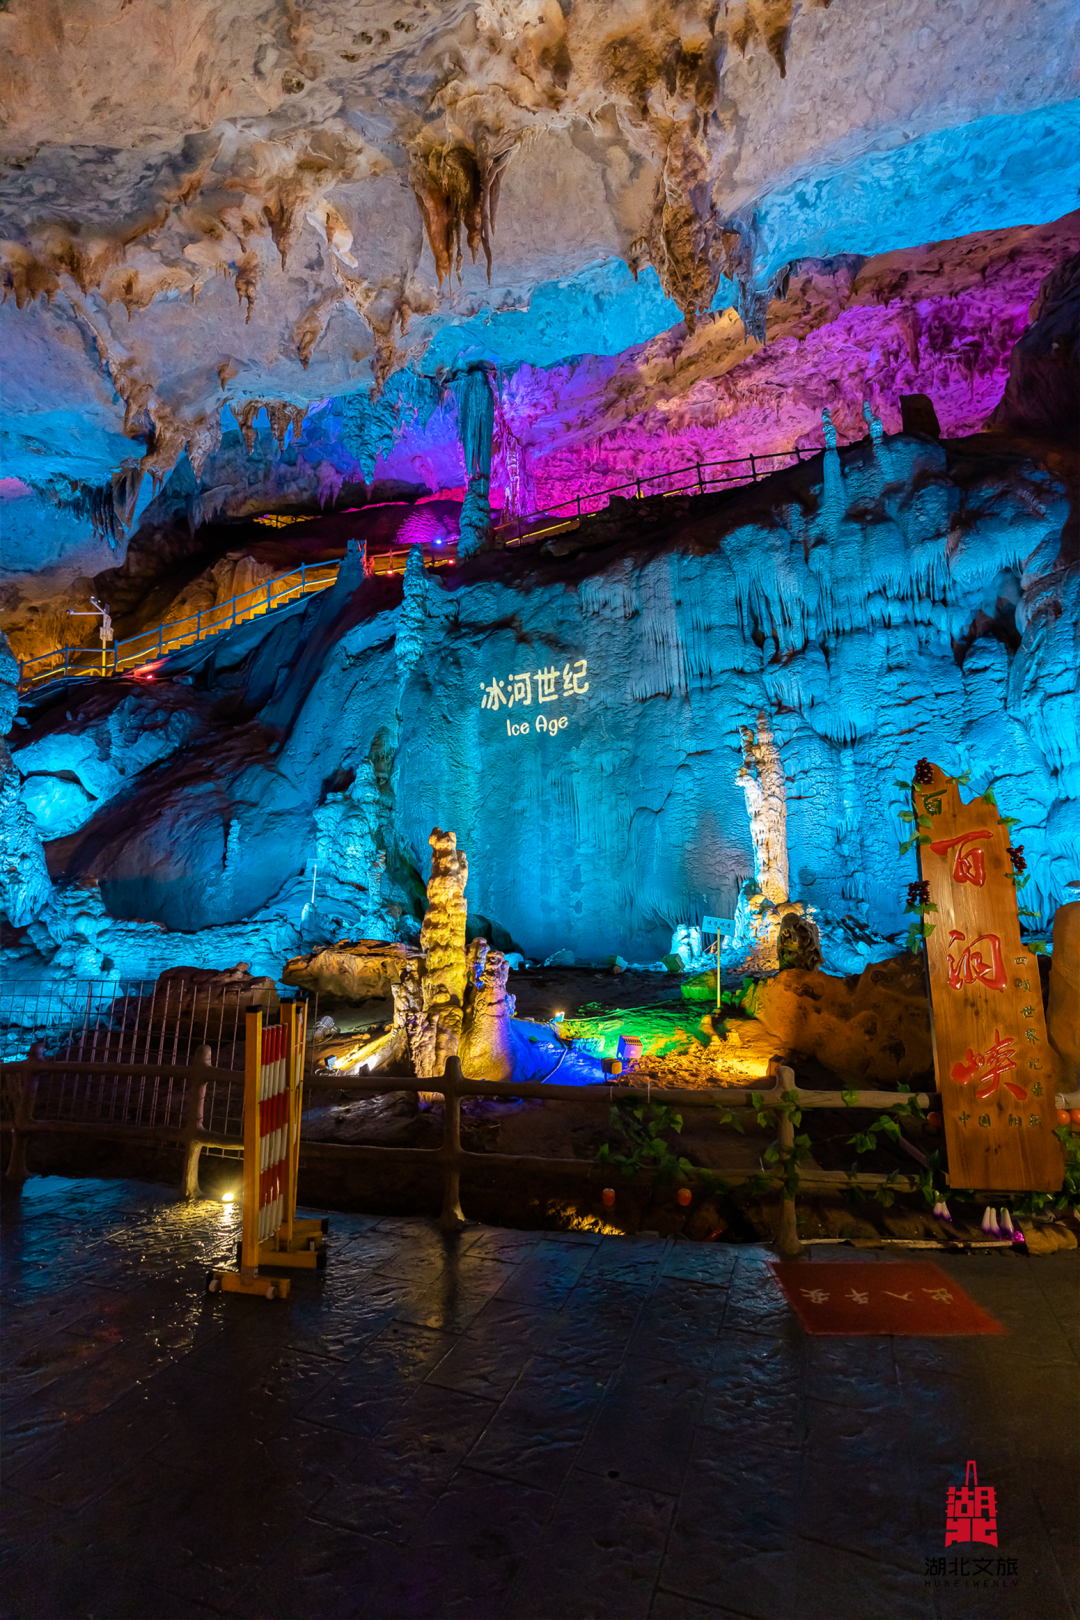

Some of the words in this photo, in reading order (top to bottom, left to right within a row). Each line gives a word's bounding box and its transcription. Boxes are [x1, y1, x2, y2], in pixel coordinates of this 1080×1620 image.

[480, 659, 589, 711] 冰河世纪
[506, 718, 530, 737] Ice
[535, 714, 569, 737] Age
